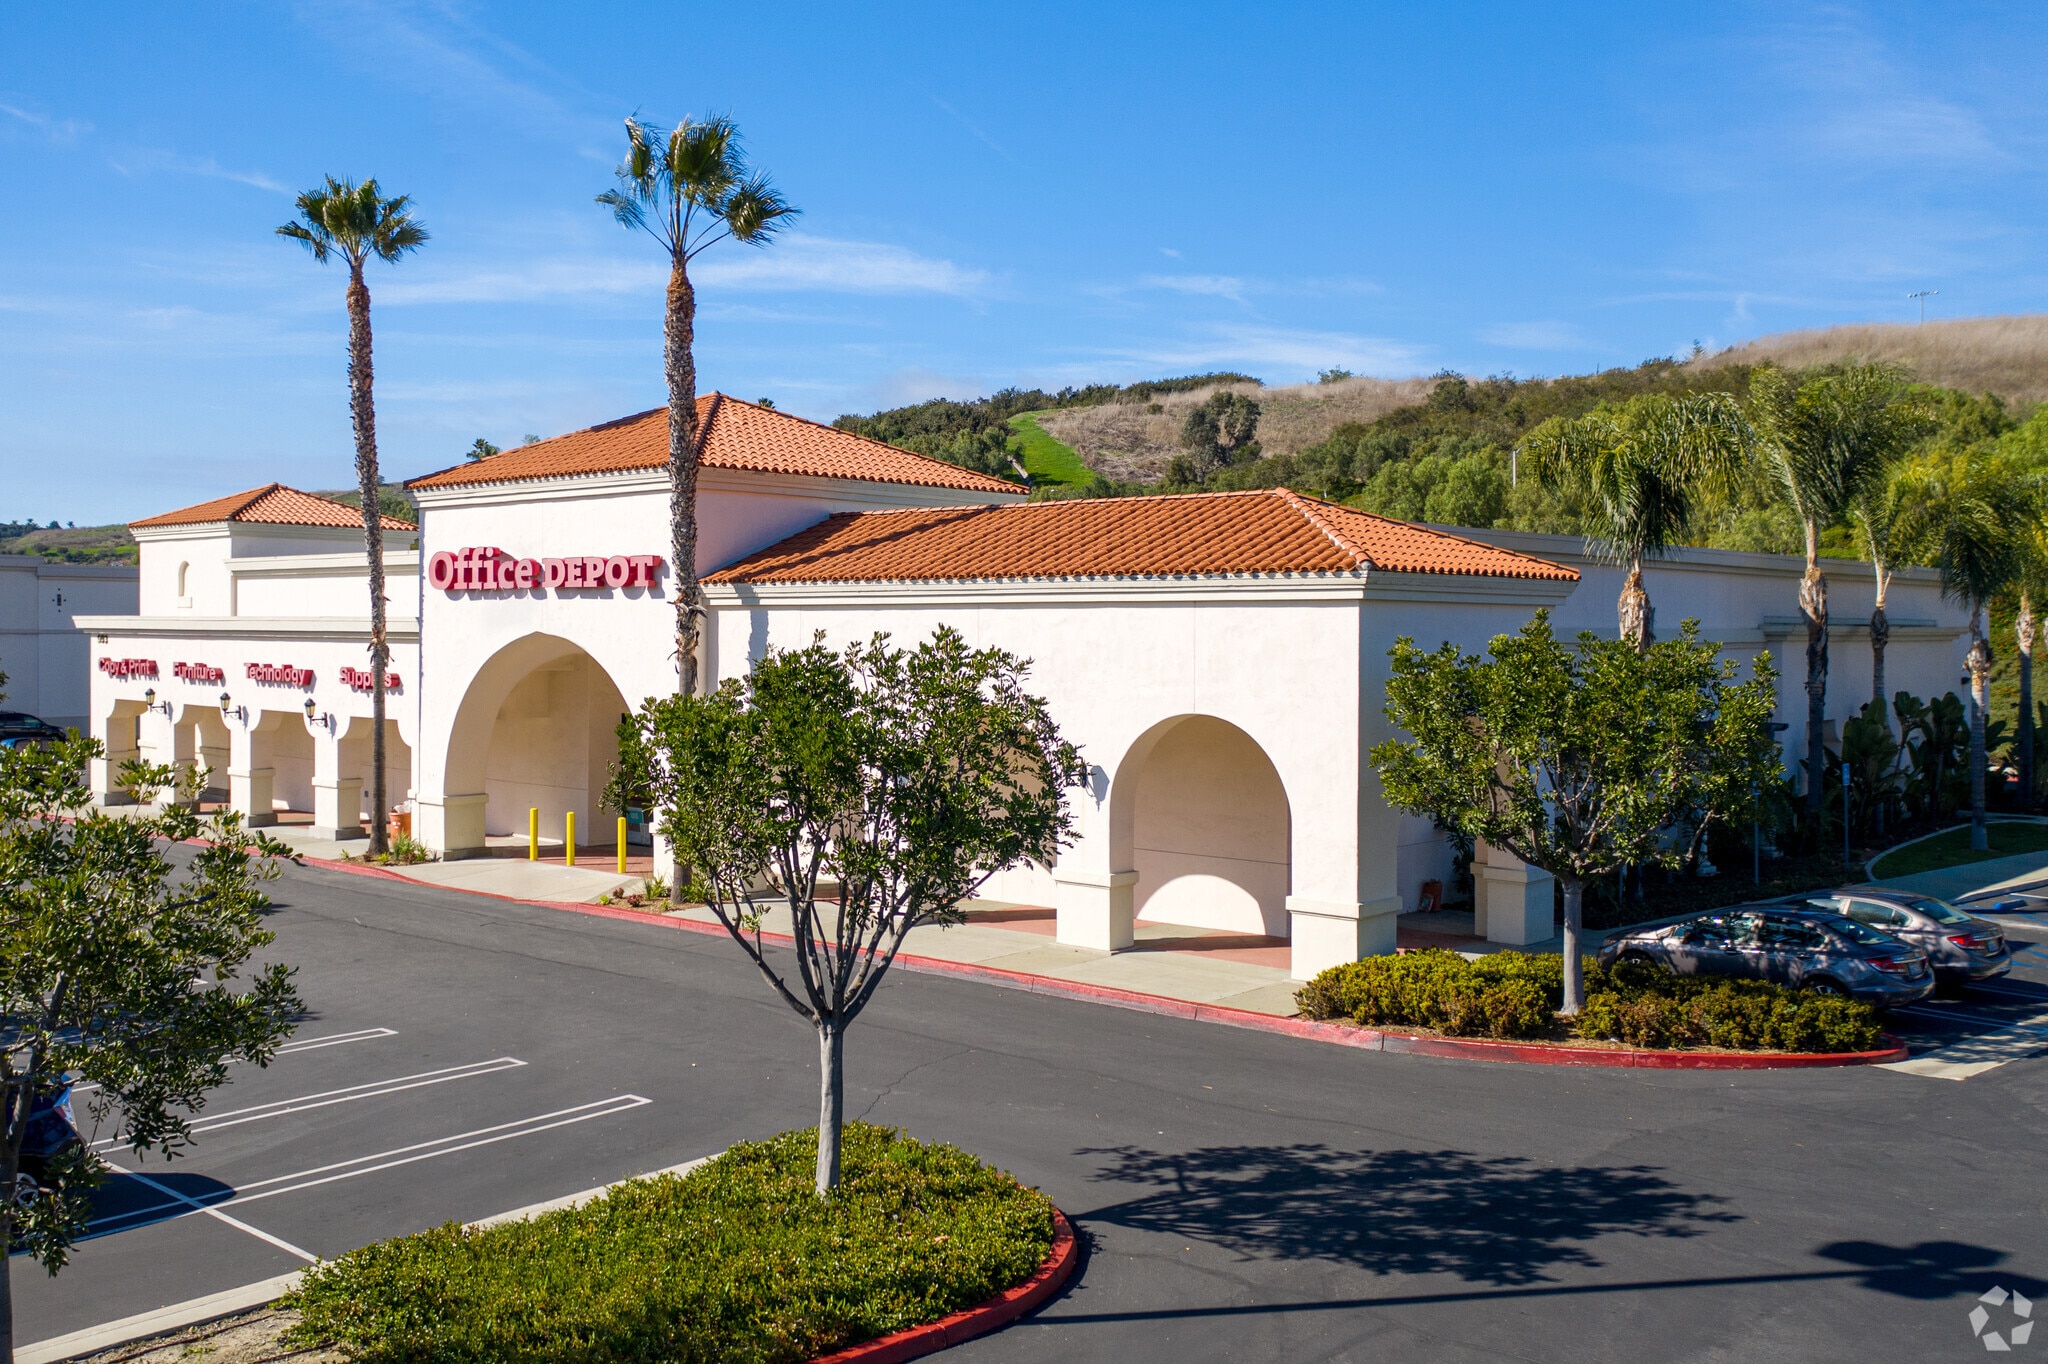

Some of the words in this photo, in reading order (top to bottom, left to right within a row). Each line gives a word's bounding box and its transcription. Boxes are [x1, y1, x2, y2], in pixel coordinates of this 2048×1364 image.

[429, 546, 533, 591] Office
[542, 555, 656, 588] DEPOT
[98, 657, 119, 676] Copy
[129, 659, 150, 675] Print
[173, 661, 216, 680] Furniture
[244, 662, 306, 686] Technology
[339, 666, 392, 689] Suppls
